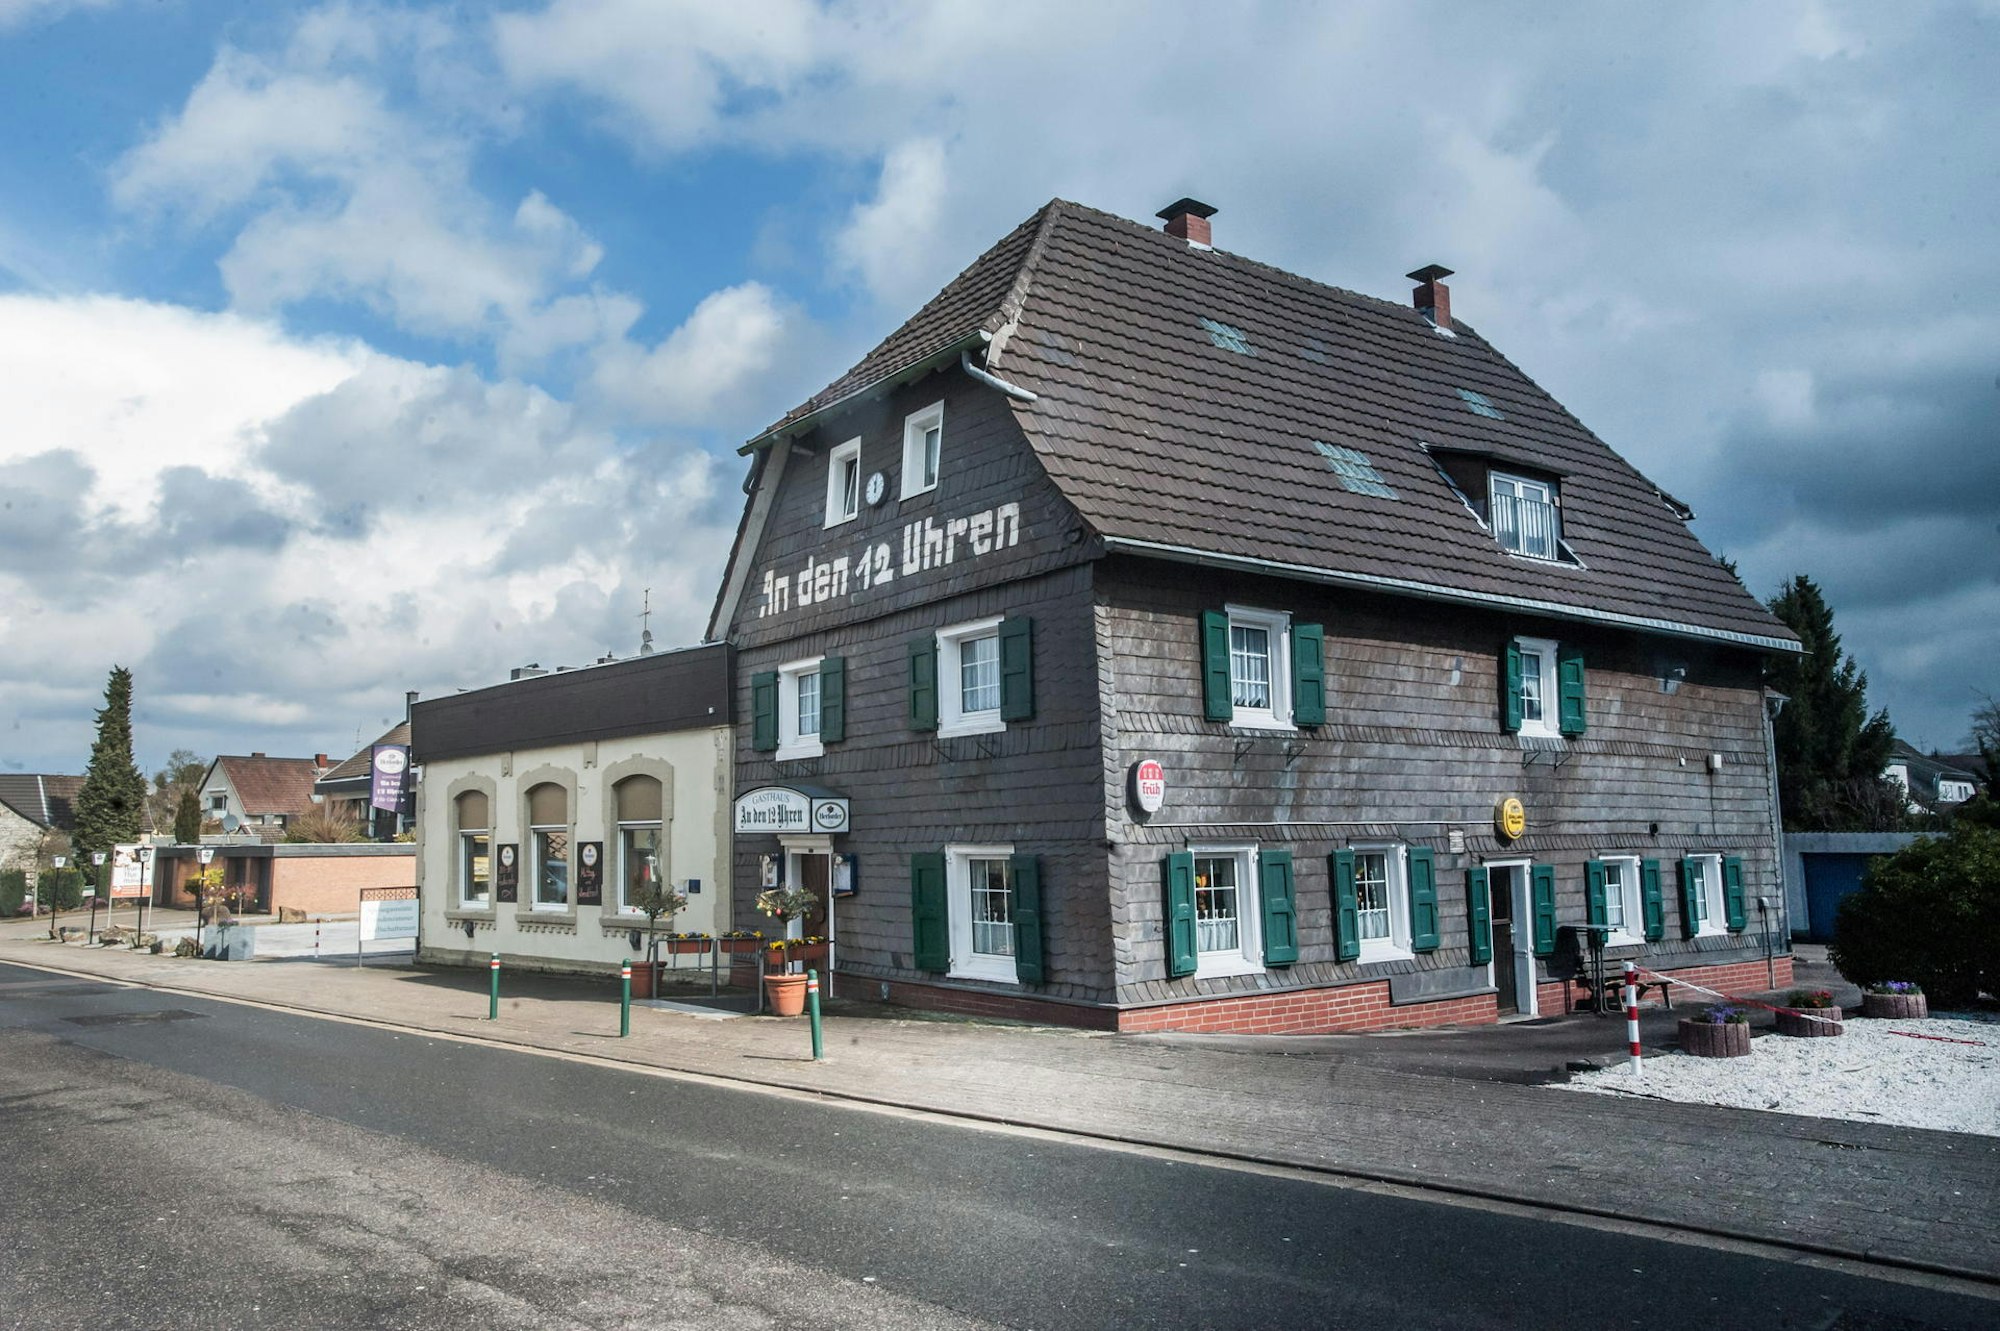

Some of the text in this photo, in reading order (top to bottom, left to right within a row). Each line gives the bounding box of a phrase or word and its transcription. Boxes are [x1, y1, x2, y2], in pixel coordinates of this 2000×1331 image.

[797, 555, 849, 607] den
[855, 542, 894, 590] 12
[902, 502, 1020, 577] Uhren
[1142, 782, 1160, 795] früh
[752, 792, 790, 805] GASTHAUS
[753, 807, 767, 824] den
[768, 806, 776, 824] 12
[777, 803, 803, 828] Uhren
